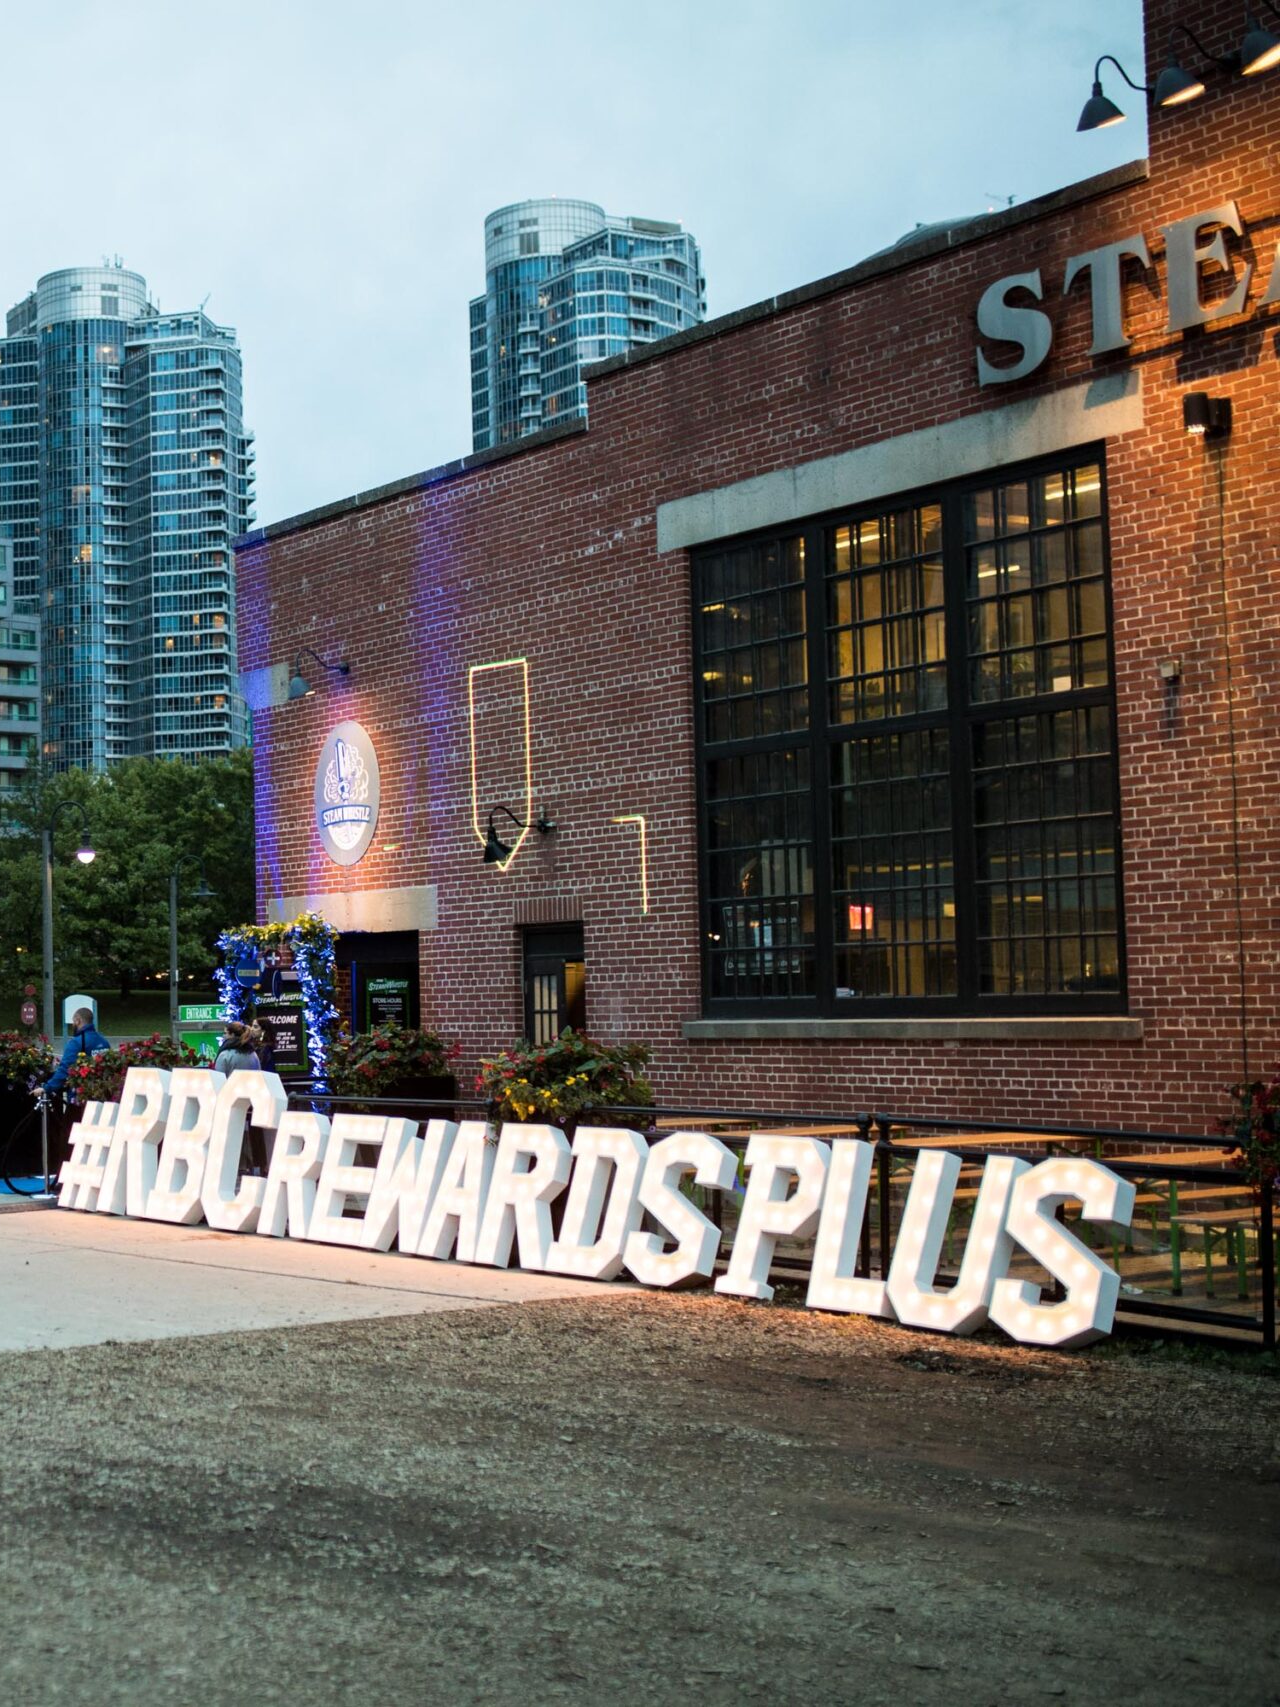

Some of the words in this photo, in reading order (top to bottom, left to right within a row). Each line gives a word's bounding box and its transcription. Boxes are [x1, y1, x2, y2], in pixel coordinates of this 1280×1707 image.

[976, 200, 1280, 388] STE
[323, 808, 343, 825] STEAM
[344, 807, 370, 821] WHISTLE
[186, 1007, 213, 1019] ENTRANCE
[267, 1015, 298, 1024] ELCOME
